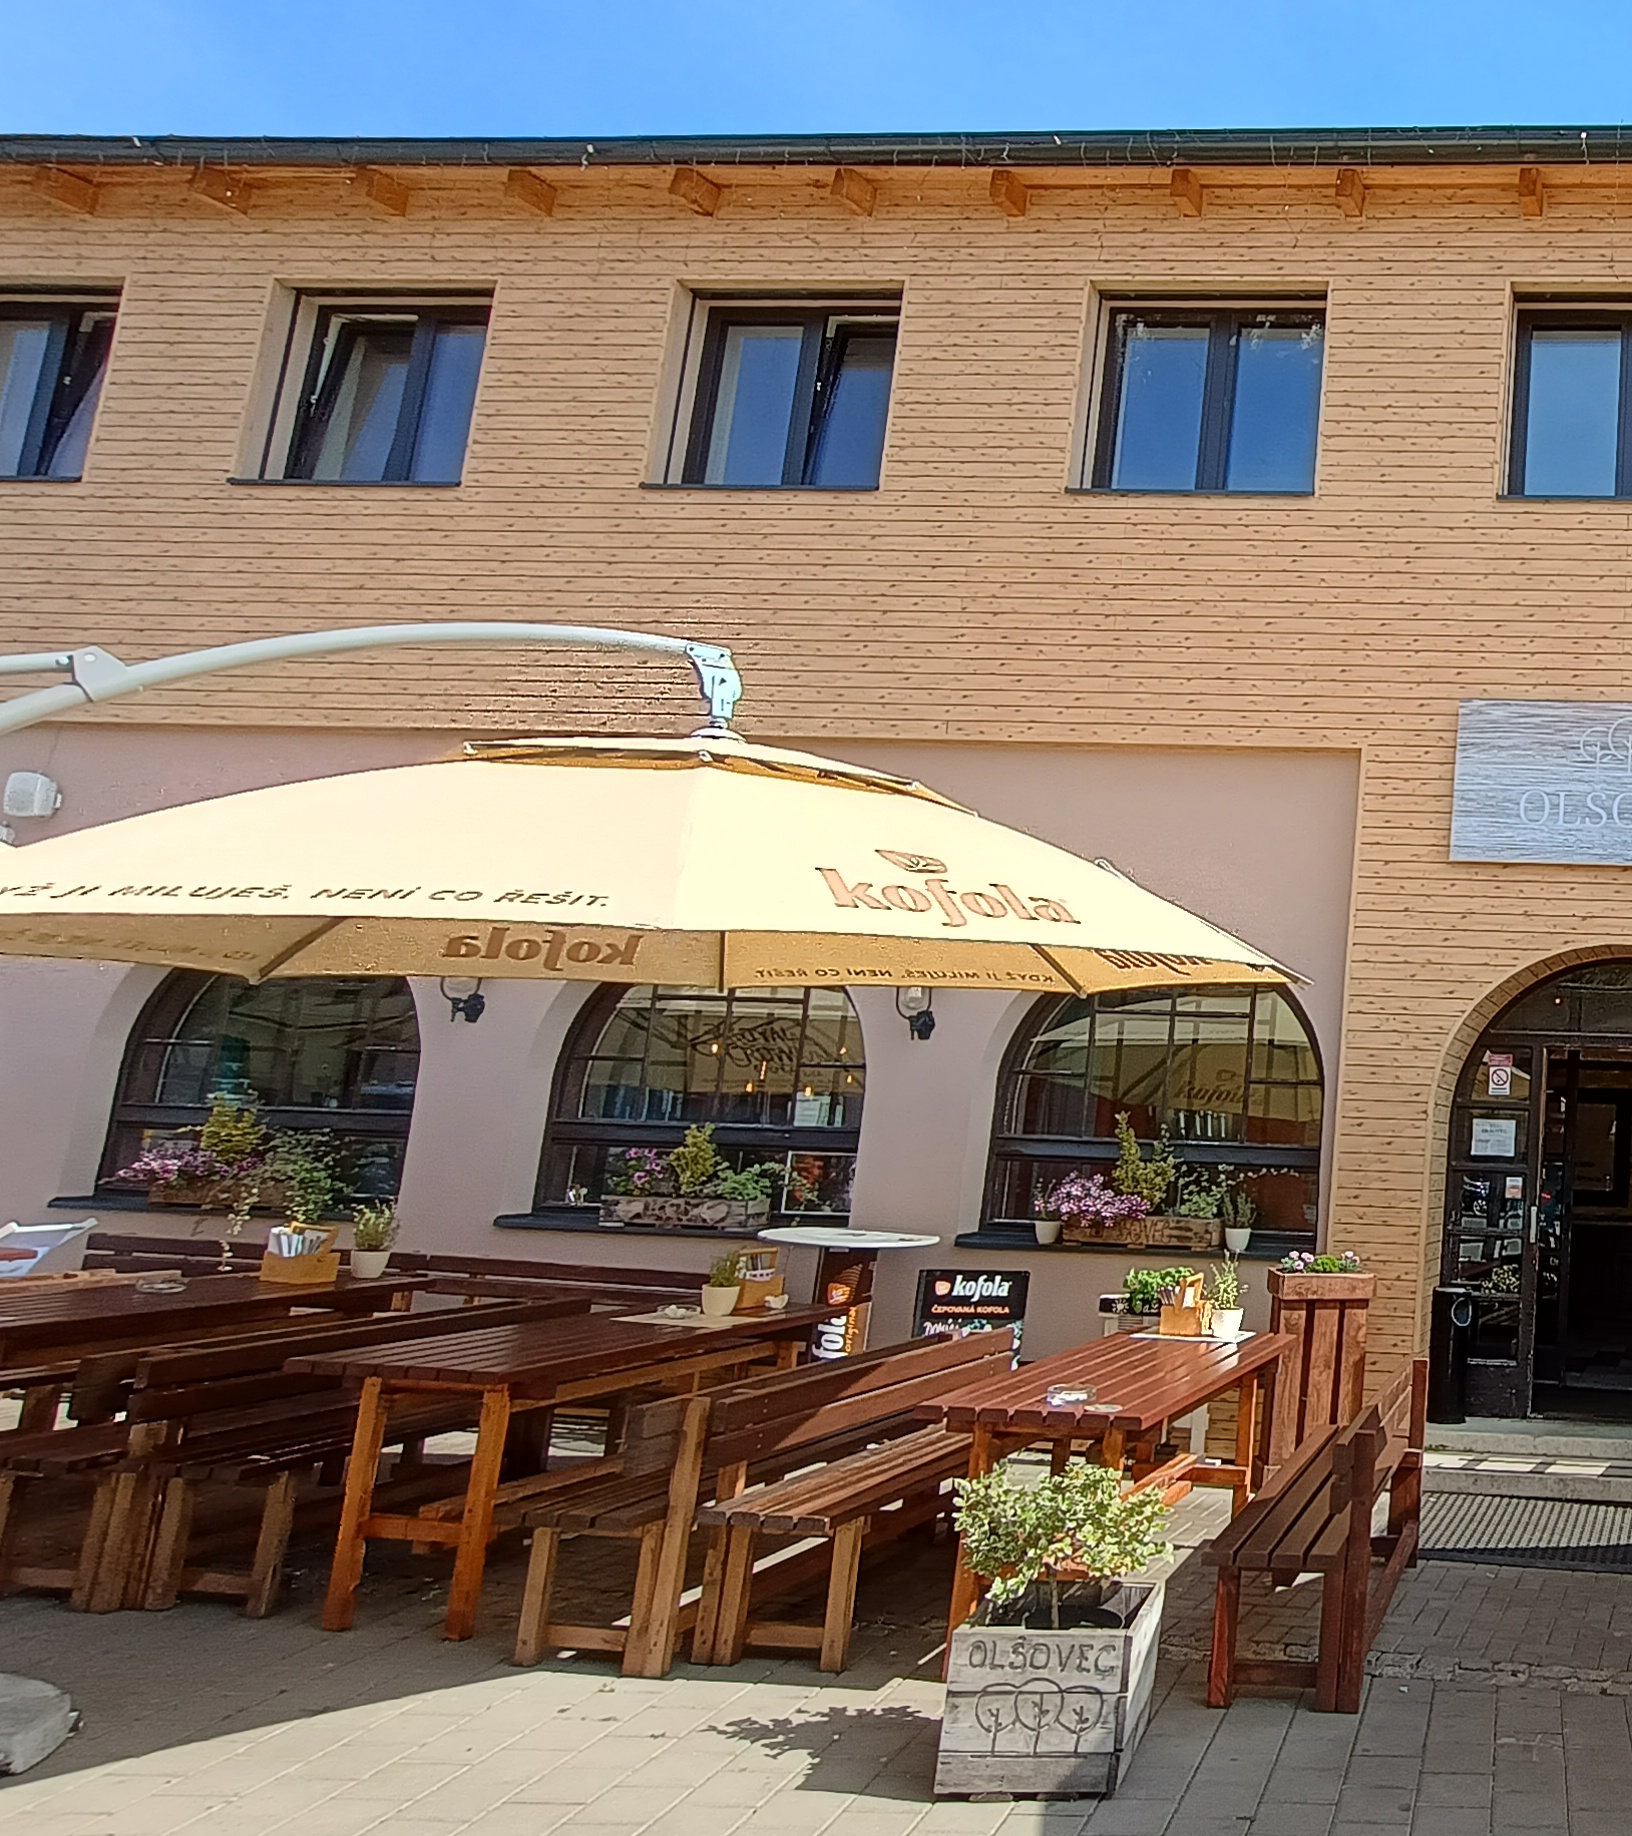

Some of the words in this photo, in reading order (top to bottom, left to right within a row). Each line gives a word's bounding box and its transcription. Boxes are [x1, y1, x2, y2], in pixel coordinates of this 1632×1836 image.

[0, 882, 54, 897] YŽ
[310, 886, 422, 900] NENÍ
[428, 889, 485, 902] CO
[493, 889, 609, 907] ŘEŠIT.
[815, 866, 1082, 928] kofola
[951, 1274, 1010, 1303] kofola
[976, 1305, 1010, 1314] KOFOLA
[811, 1315, 849, 1359] fola
